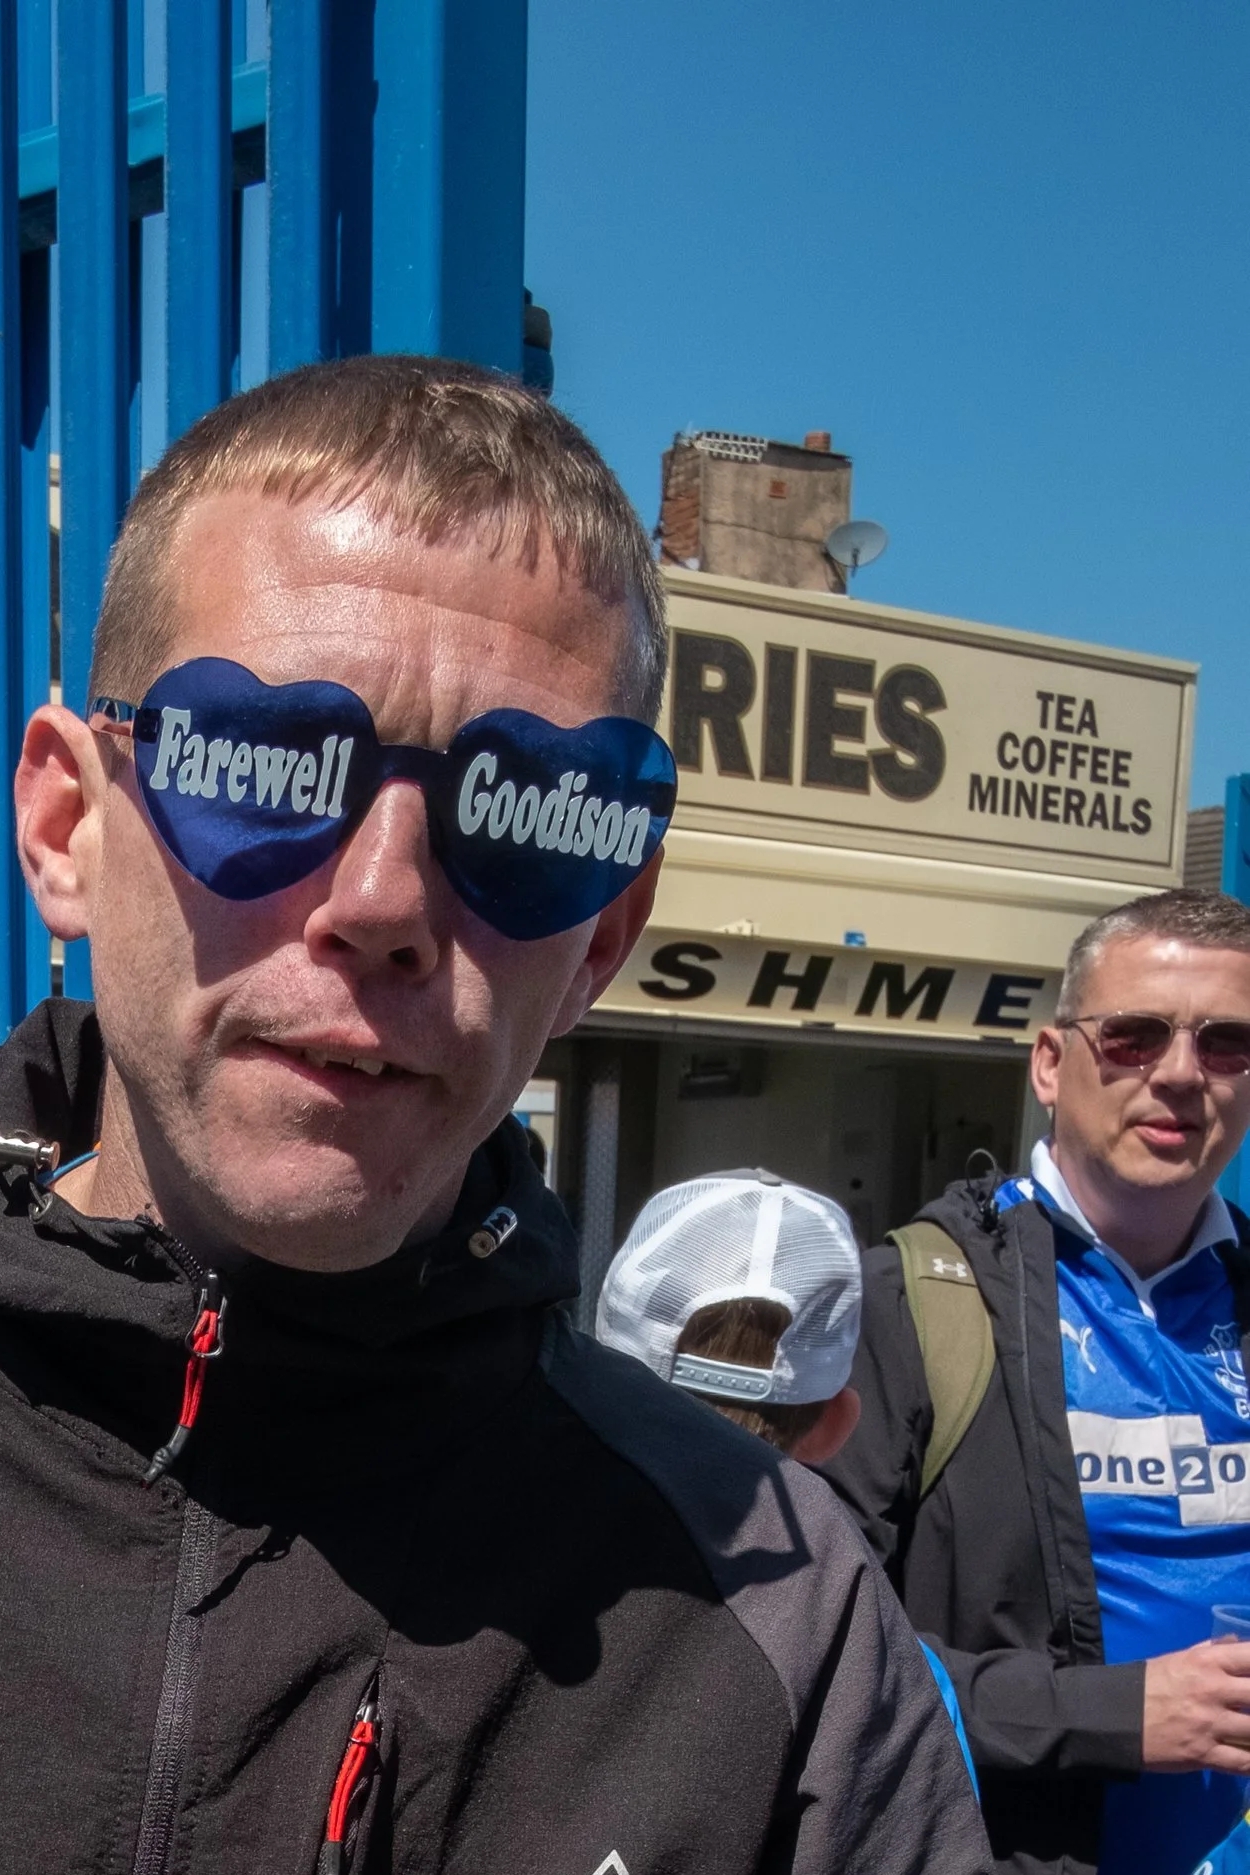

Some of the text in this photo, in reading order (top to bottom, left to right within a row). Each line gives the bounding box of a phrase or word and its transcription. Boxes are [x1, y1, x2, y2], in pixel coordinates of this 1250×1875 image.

[669, 627, 948, 802] RIES
[1036, 690, 1099, 738] TEA
[150, 706, 651, 867] Farewell Goodison
[996, 732, 1132, 788] COFFEE
[968, 773, 1152, 836] MINERALS
